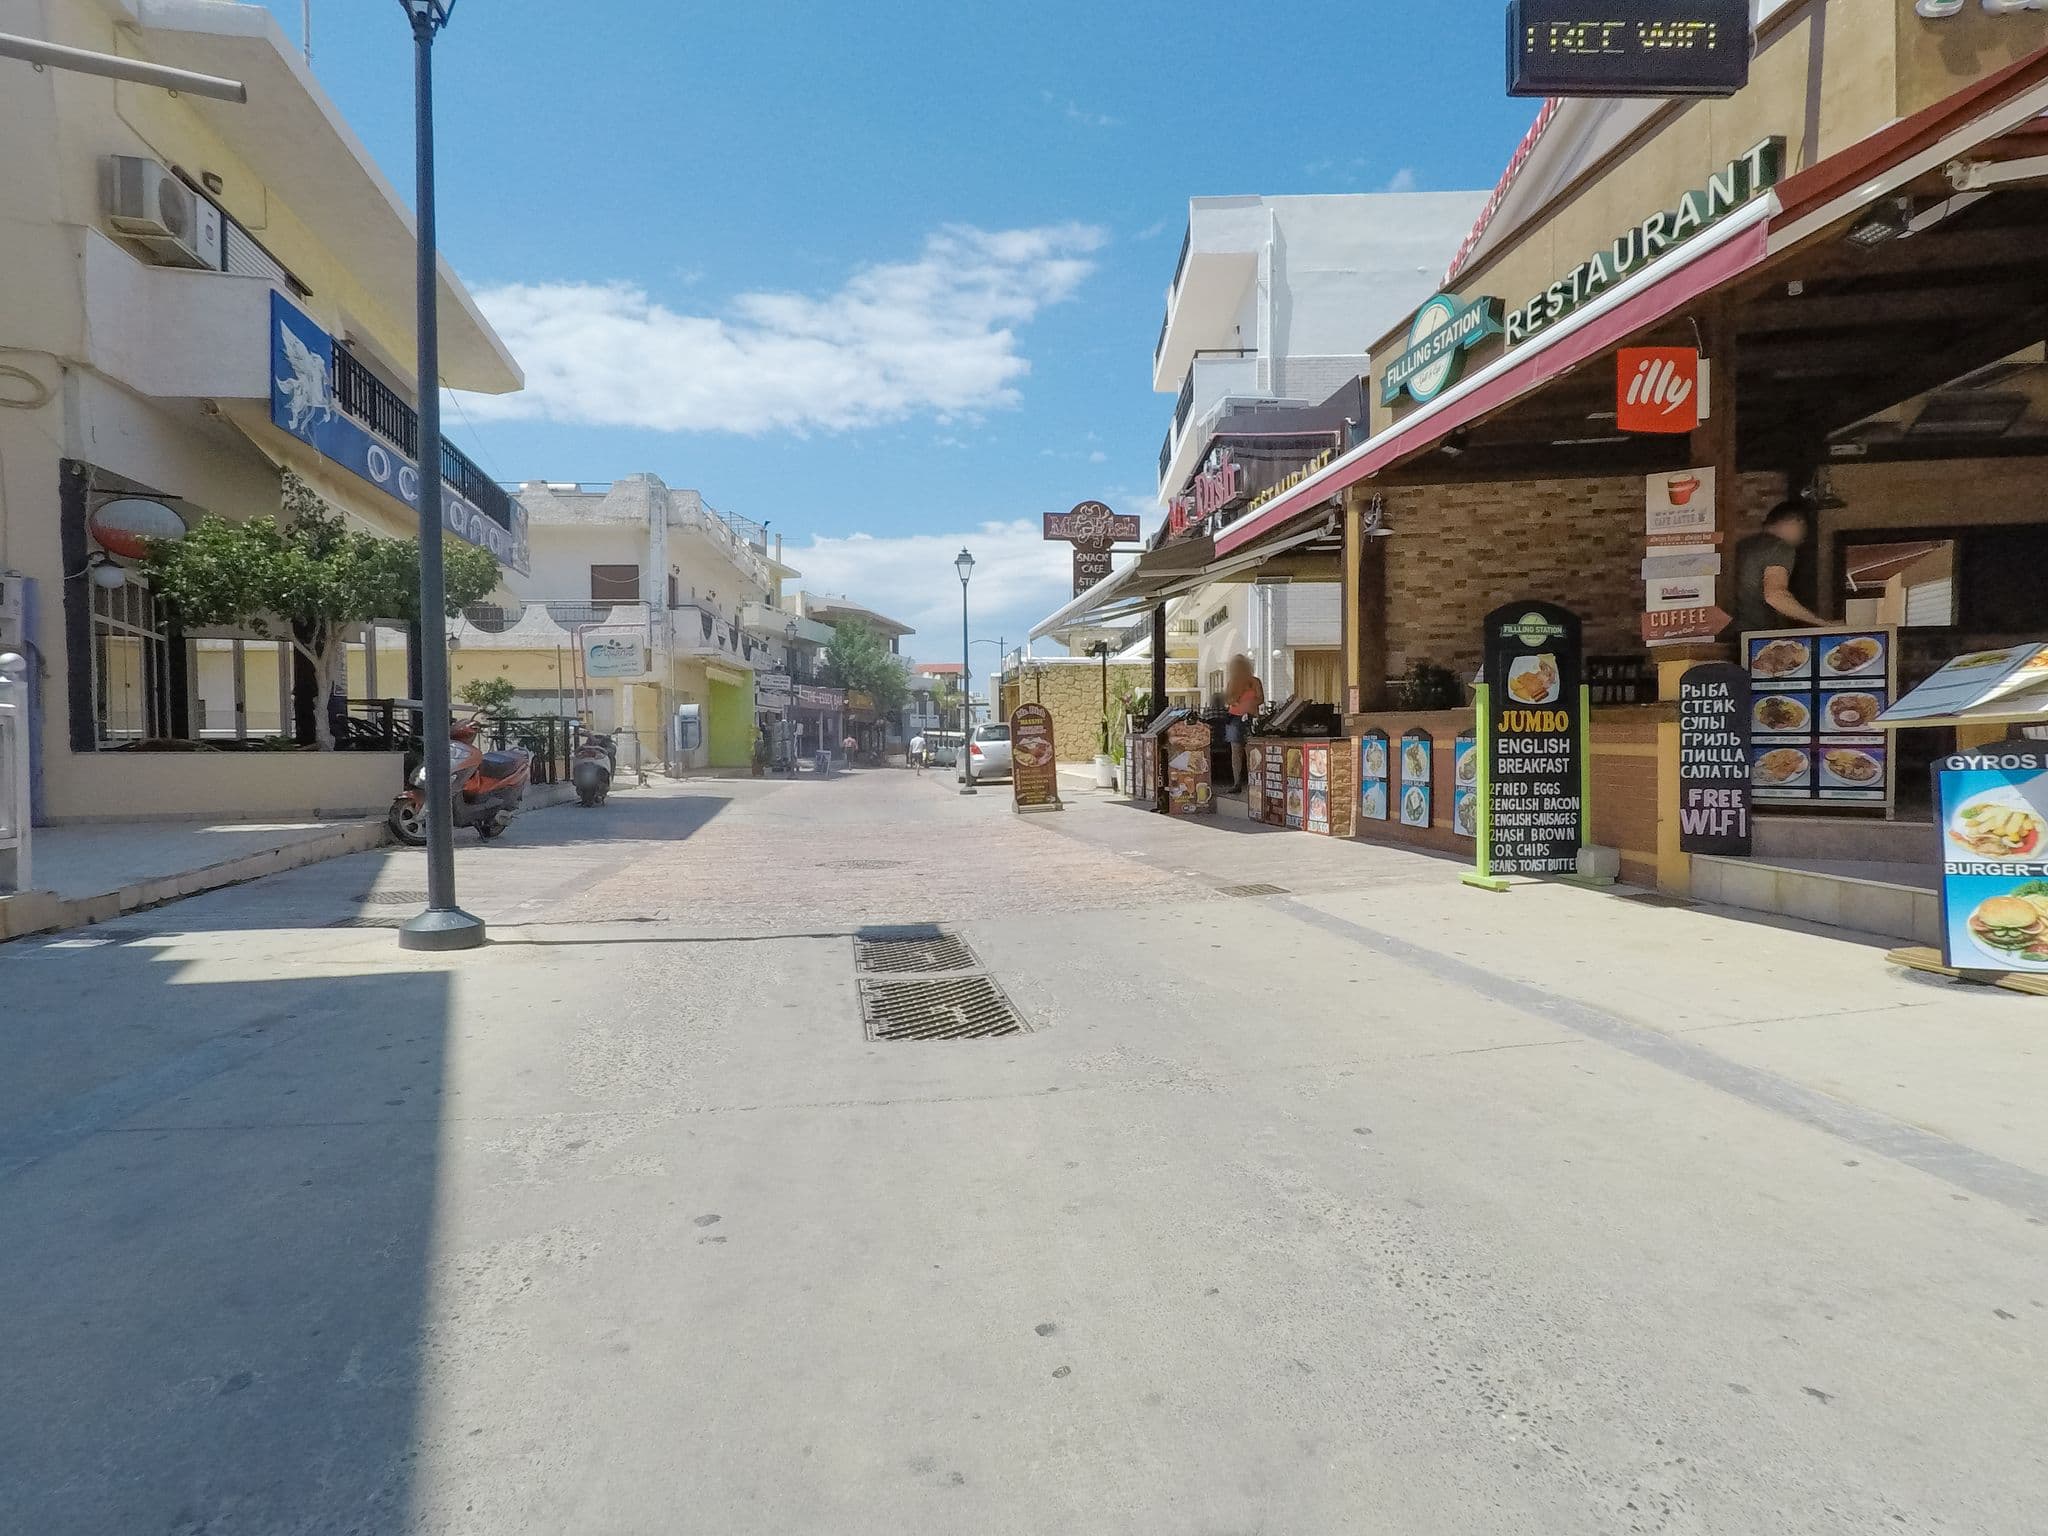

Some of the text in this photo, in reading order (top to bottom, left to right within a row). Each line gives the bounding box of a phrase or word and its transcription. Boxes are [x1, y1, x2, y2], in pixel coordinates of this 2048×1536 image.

[1505, 136, 1772, 346] RESTAURANT
[1432, 304, 1482, 355] STATION
[1626, 358, 1693, 416] illy
[1081, 564, 1106, 574] CAFE
[1650, 608, 1707, 627] COFFEE
[1535, 625, 1563, 634] STATION
[1681, 682, 1729, 699] РЫБА
[1498, 710, 1569, 733] JUMBO
[1680, 715, 1726, 730] СУПЫ
[1498, 738, 1571, 754] ENGLISH
[1681, 732, 1741, 747] ГРИЛЬ
[1680, 748, 1745, 763] ПИЦЦА
[1946, 754, 2038, 770] GYROS
[1498, 758, 1570, 774] BREAKFAST
[1680, 764, 1750, 779] САЛАТЫ
[1533, 782, 1561, 795] EGGS
[1543, 797, 1580, 810] BACON
[1688, 788, 1743, 808] FREE
[1532, 812, 1577, 826] SAUSAGES
[1531, 827, 1575, 841] BROWN
[1495, 843, 1550, 857] OR CHIPS
[1518, 858, 1547, 872] TOAST
